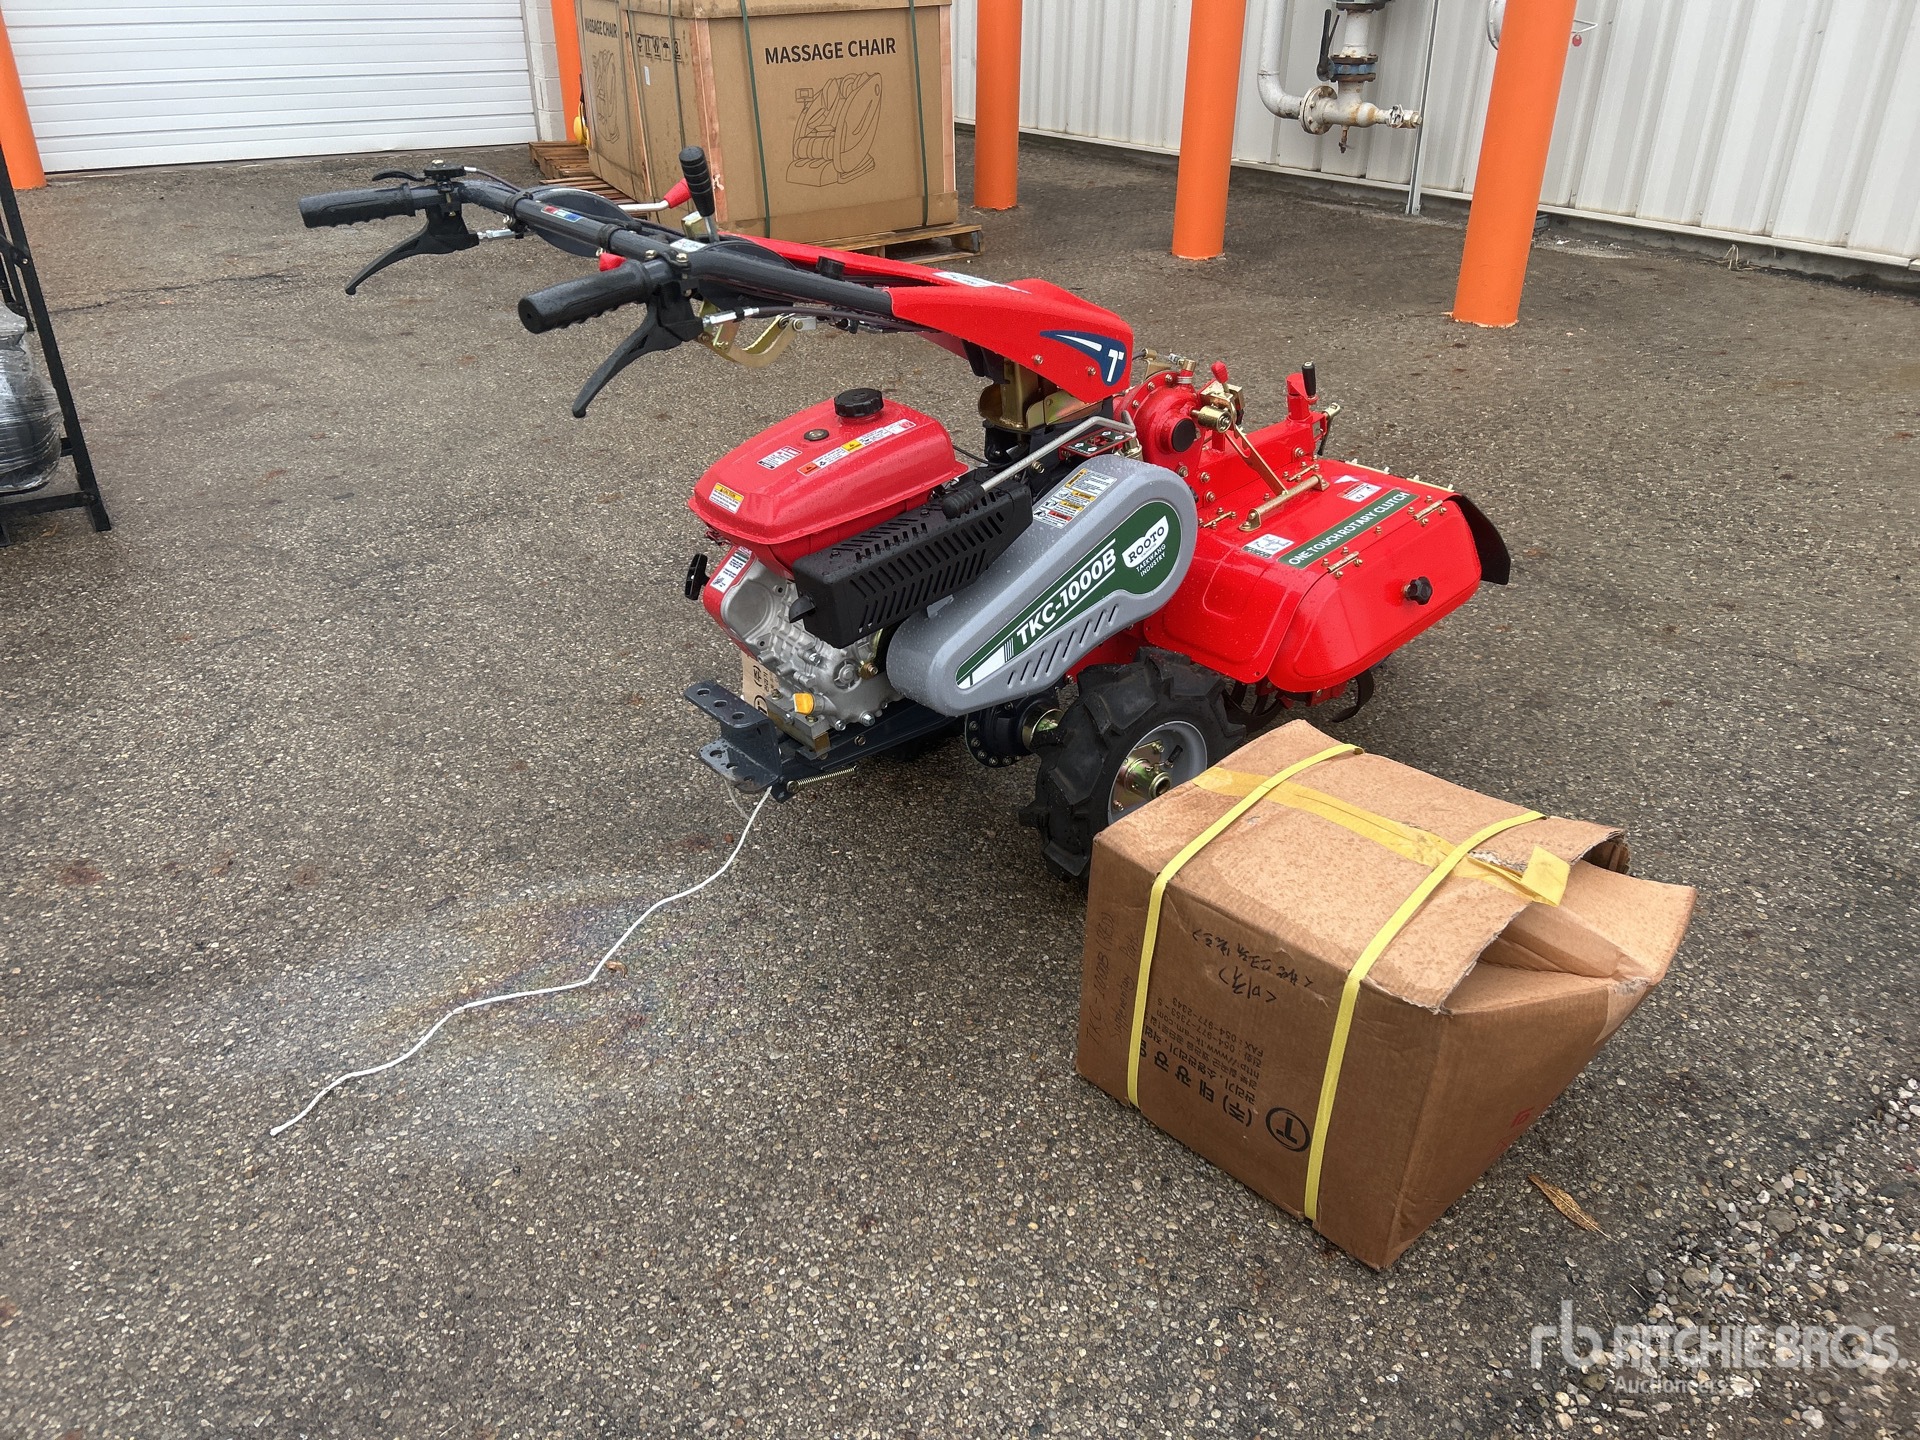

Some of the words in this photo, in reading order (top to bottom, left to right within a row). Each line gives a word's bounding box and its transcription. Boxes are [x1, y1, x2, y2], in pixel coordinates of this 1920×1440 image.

[603, 21, 617, 38] CHAIR
[764, 41, 844, 65] MASSAGE
[847, 37, 897, 58] CHAIR
[1289, 549, 1313, 565] ONE
[1309, 533, 1342, 553] TOUCH
[1339, 512, 1376, 536] ROTARY
[1374, 491, 1411, 514] CLUTCH
[1127, 524, 1165, 564] ROOTO
[1135, 543, 1167, 573] TAEKWANG
[1139, 552, 1167, 576] INDUSTRY
[1016, 547, 1116, 646] TKC-1000B
[1171, 996, 1237, 1043] 054-977-2343
[1243, 1040, 1263, 1058] FAX
[1222, 1094, 1253, 1127] (주)
